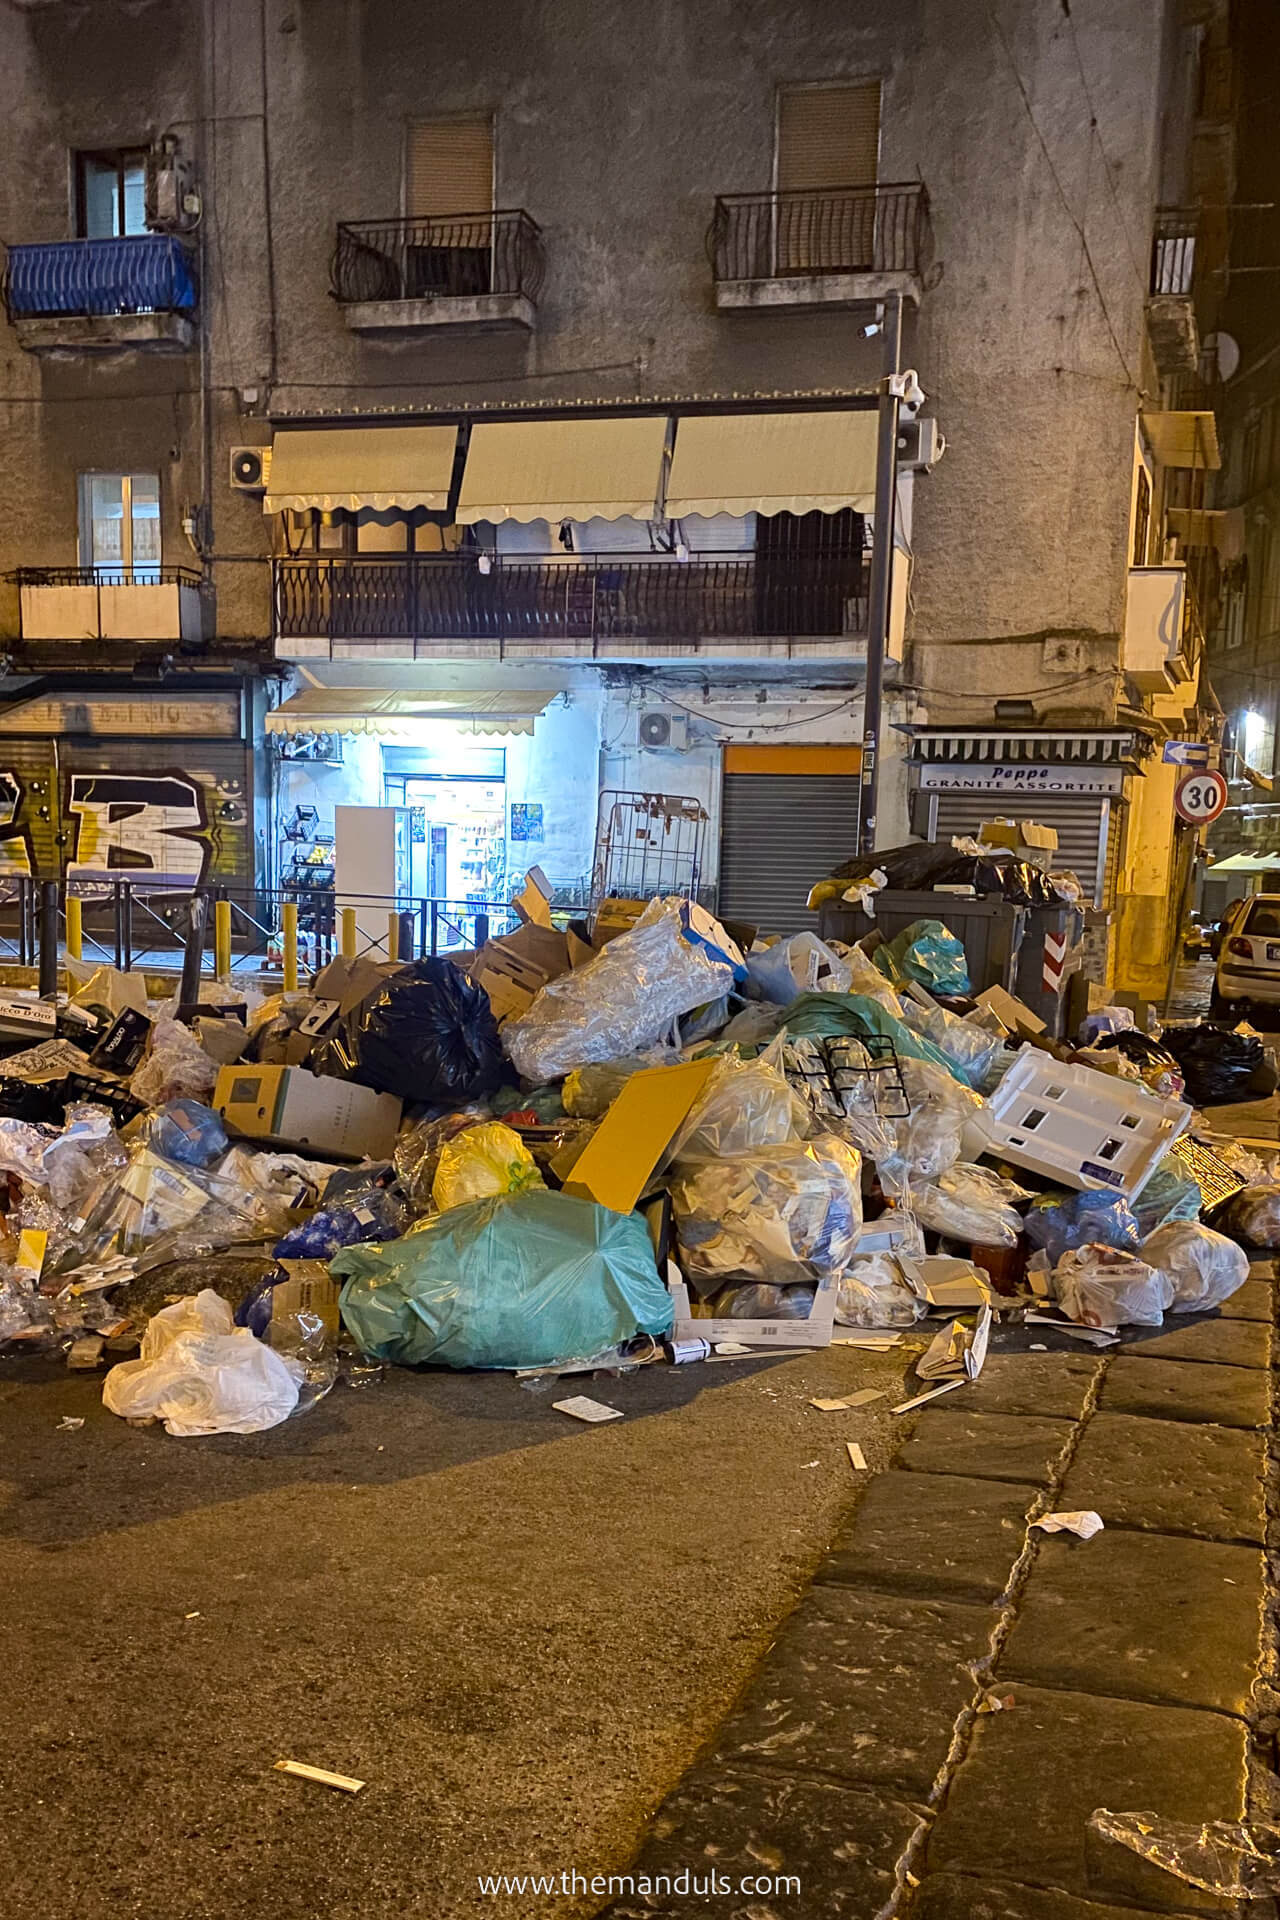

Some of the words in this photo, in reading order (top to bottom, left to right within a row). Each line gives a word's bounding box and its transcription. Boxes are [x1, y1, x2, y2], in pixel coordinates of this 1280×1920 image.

[992, 767, 1049, 780] Peppe
[926, 780, 1004, 788] GRANITE
[1014, 782, 1116, 792] ASSORTITE
[1188, 786, 1217, 809] 30
